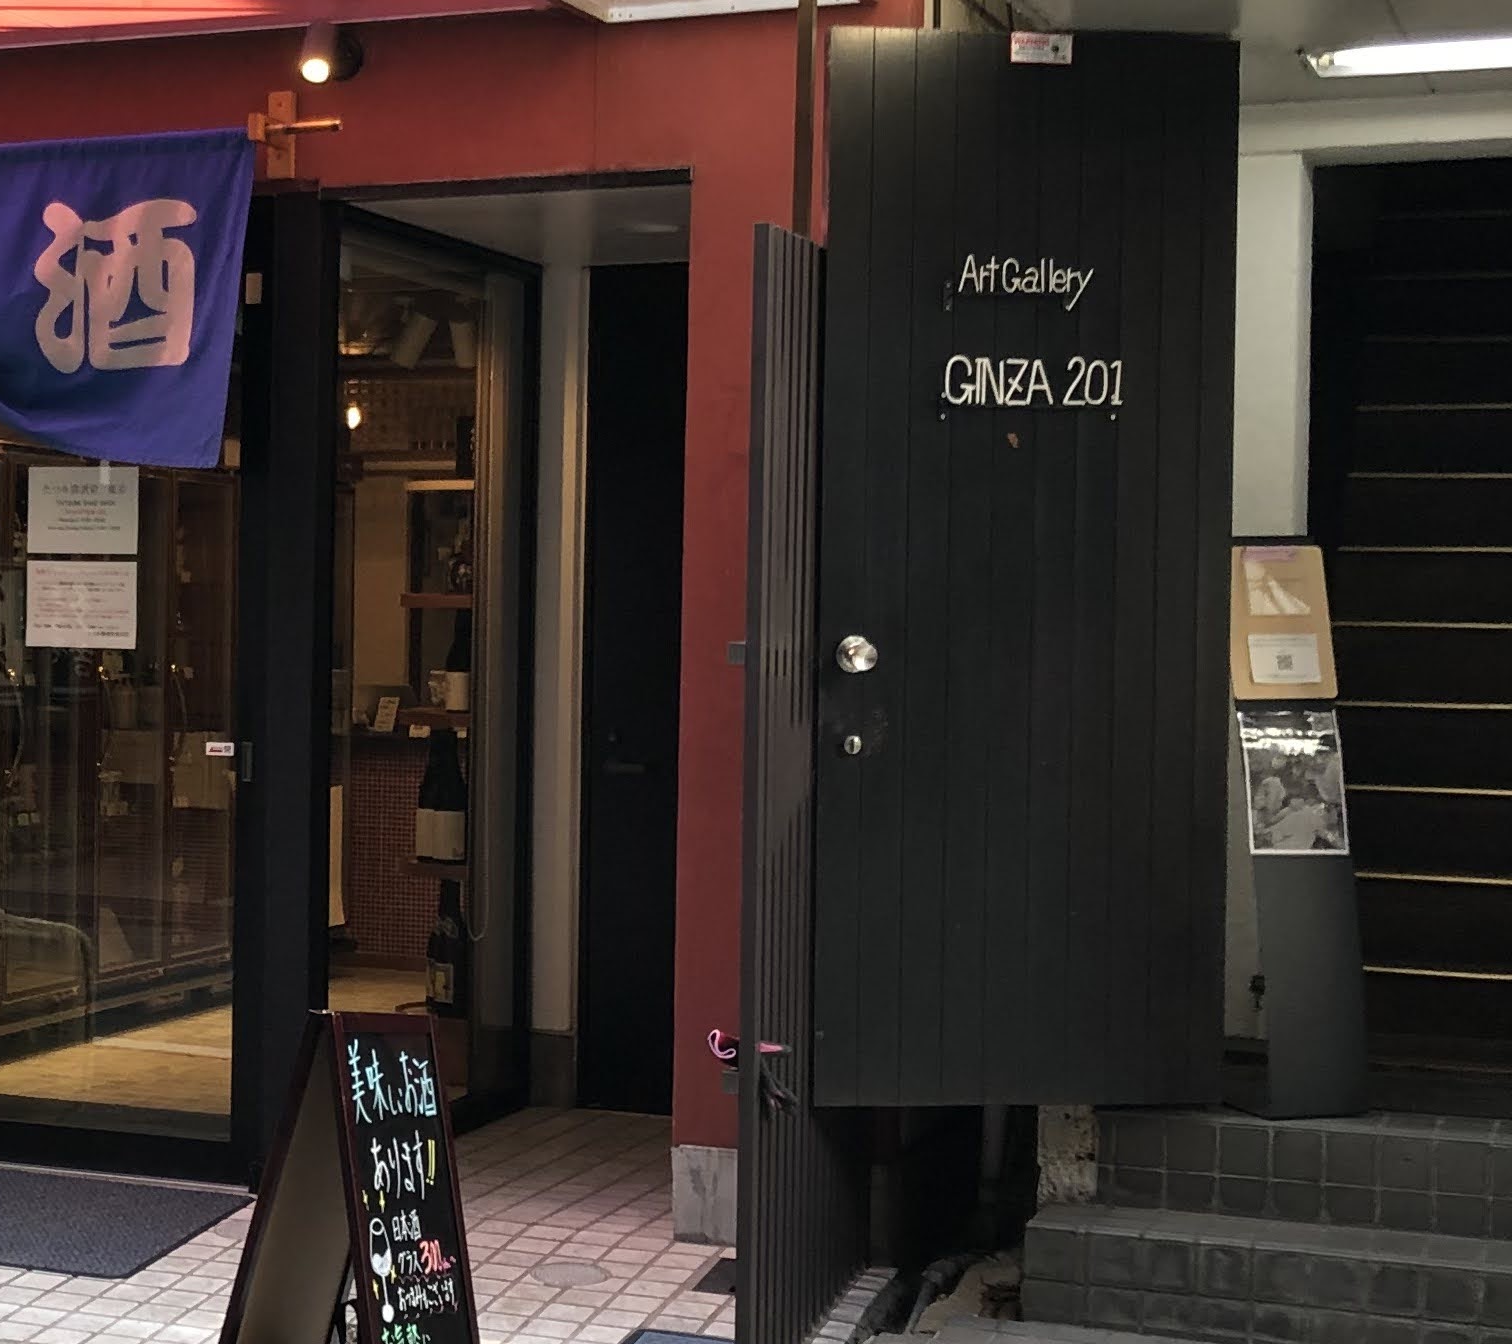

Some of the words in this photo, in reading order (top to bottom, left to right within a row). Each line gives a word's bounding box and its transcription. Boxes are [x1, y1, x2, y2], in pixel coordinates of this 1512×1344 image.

[34, 199, 197, 373] 酒
[958, 254, 999, 293] Art
[1001, 257, 1094, 311] Gallery
[944, 354, 1054, 406] GINZA
[1062, 355, 1123, 406] 201
